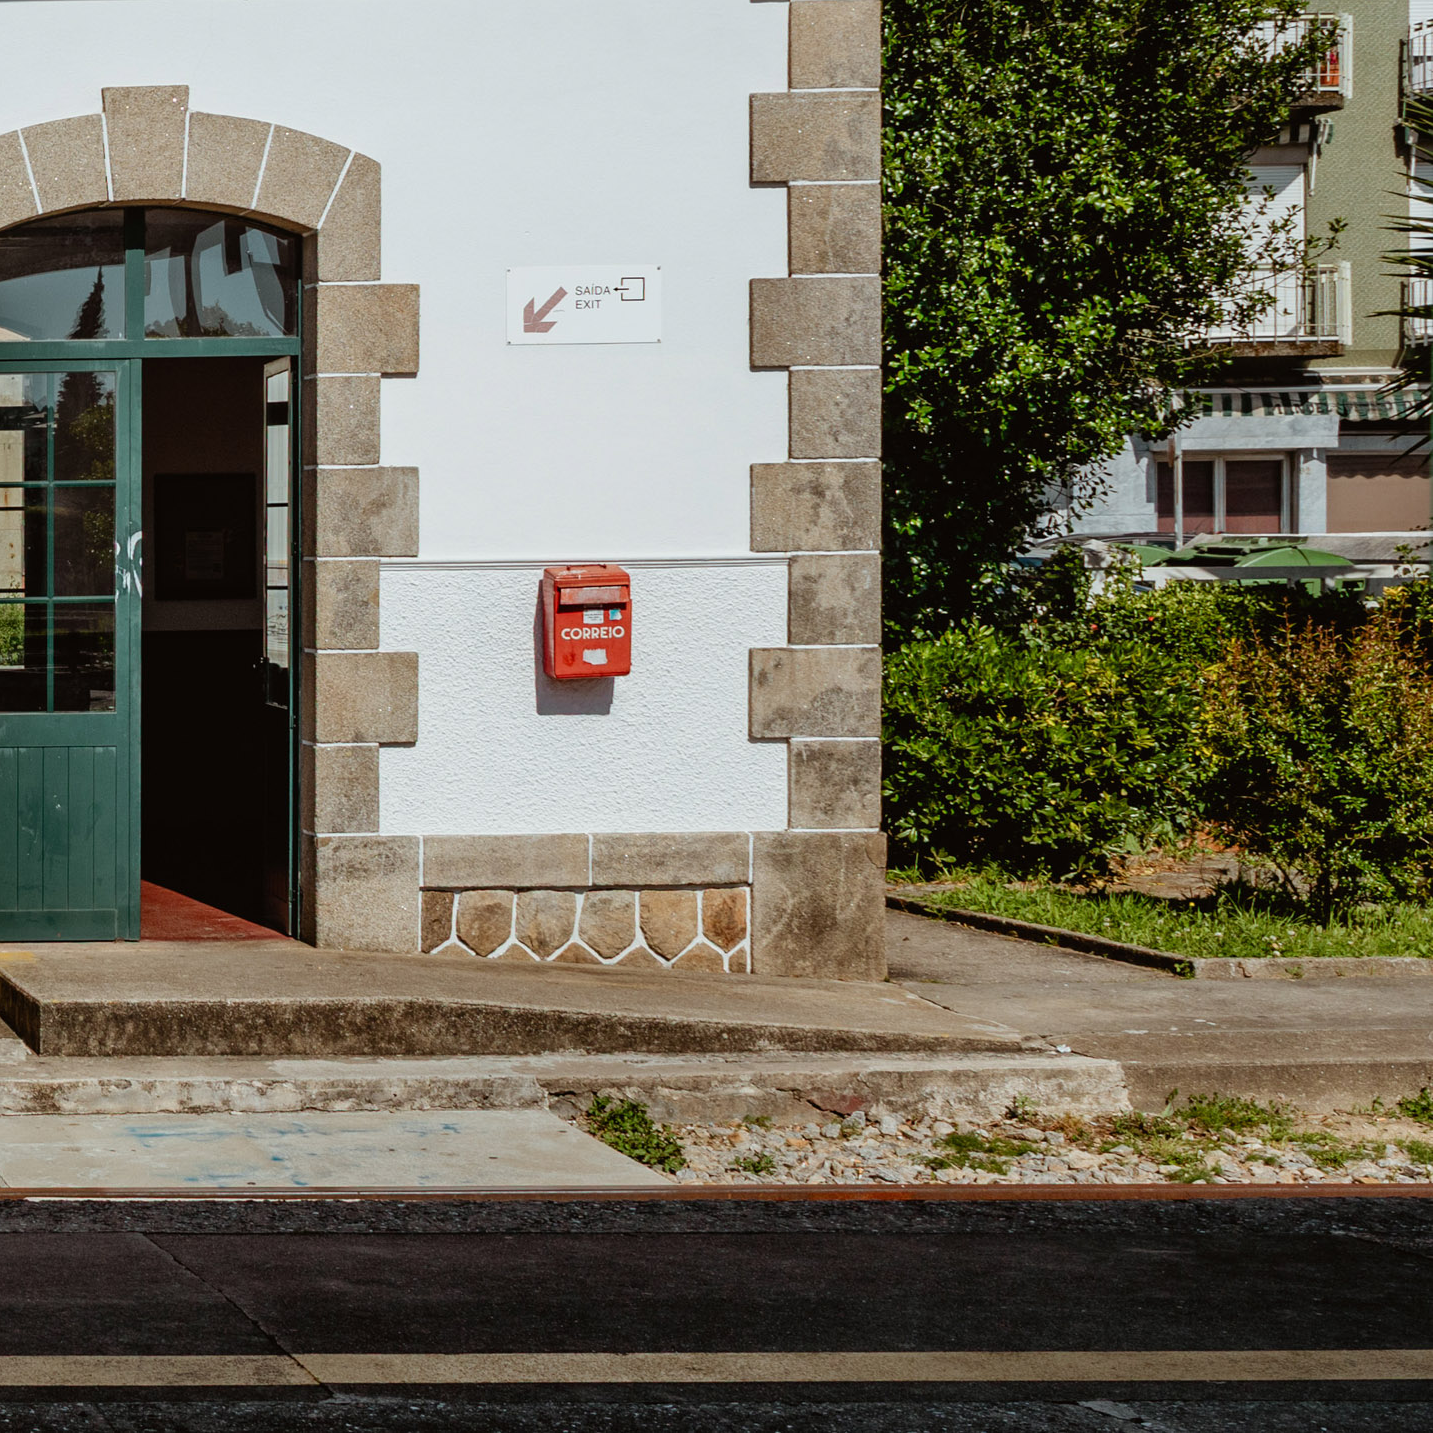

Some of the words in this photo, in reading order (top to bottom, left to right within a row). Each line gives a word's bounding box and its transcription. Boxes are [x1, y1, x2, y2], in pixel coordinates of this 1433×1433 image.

[574, 283, 611, 296] SAÍDA
[575, 299, 602, 310] EXIT
[561, 625, 625, 641] CORREIO
